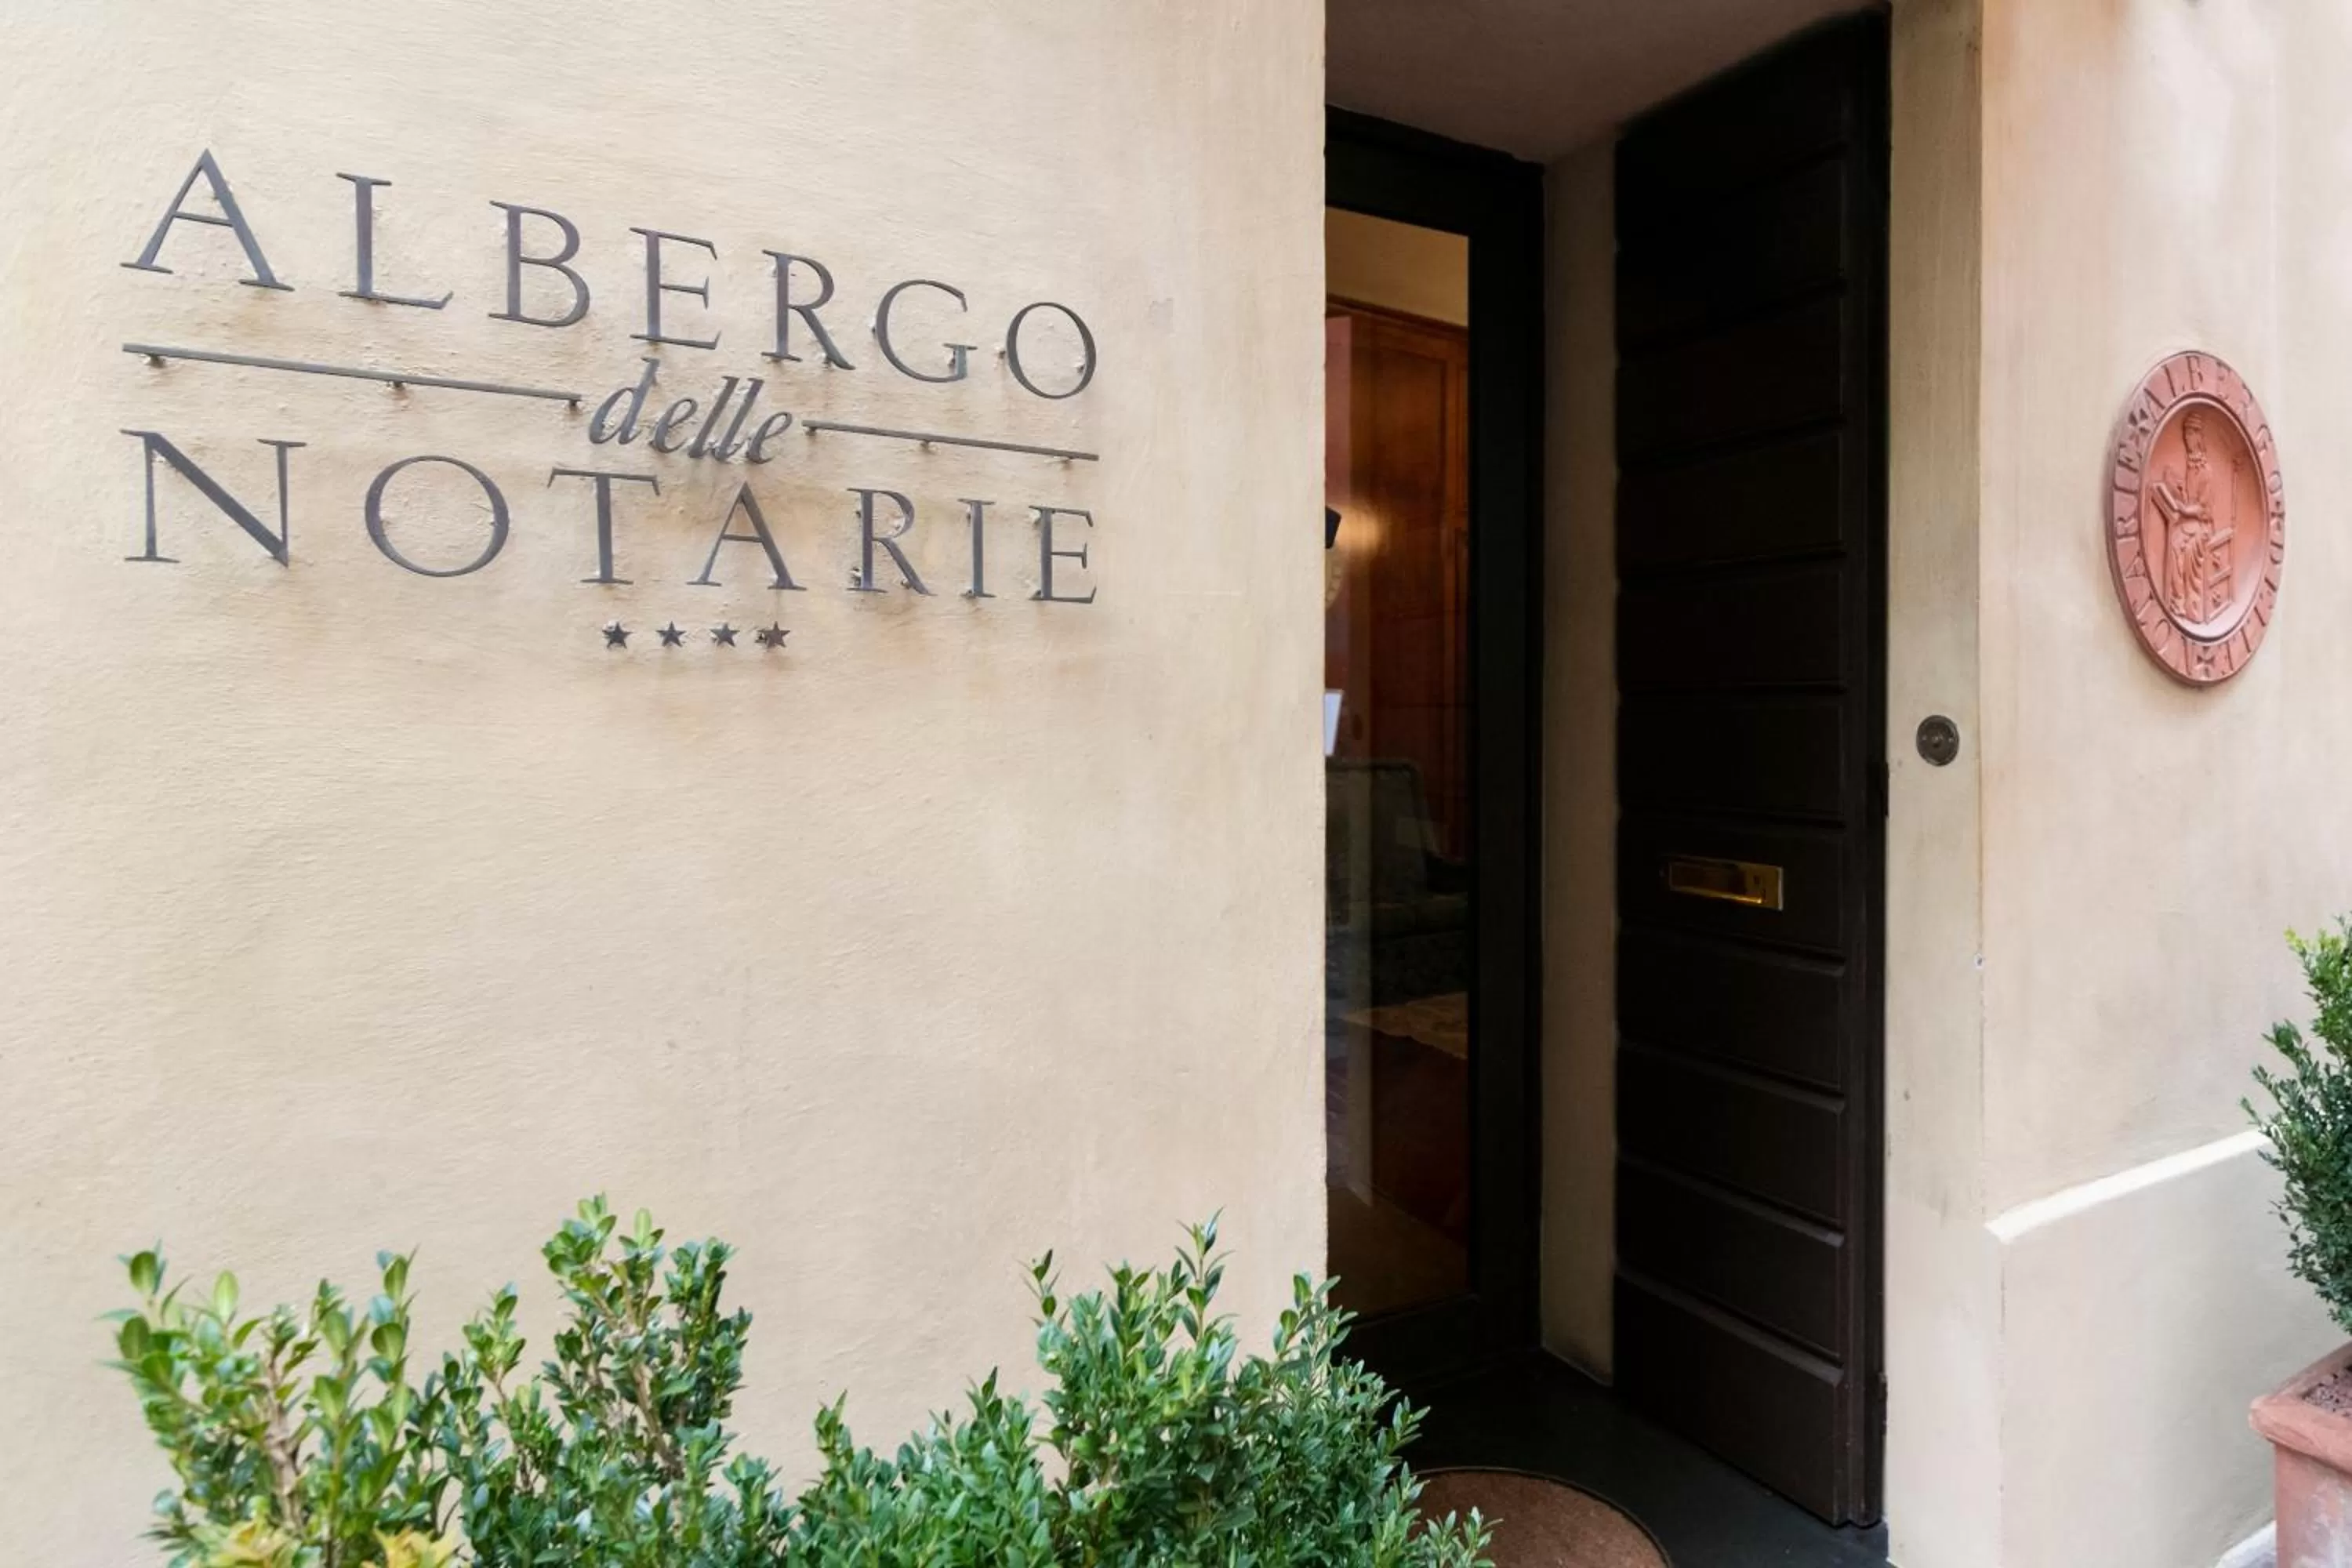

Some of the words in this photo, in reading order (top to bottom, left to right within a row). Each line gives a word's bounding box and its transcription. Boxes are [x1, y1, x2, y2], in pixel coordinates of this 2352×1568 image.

[119, 147, 1097, 400] ALBERGO
[587, 357, 793, 464] delle
[119, 428, 1098, 604] NOTARIE
